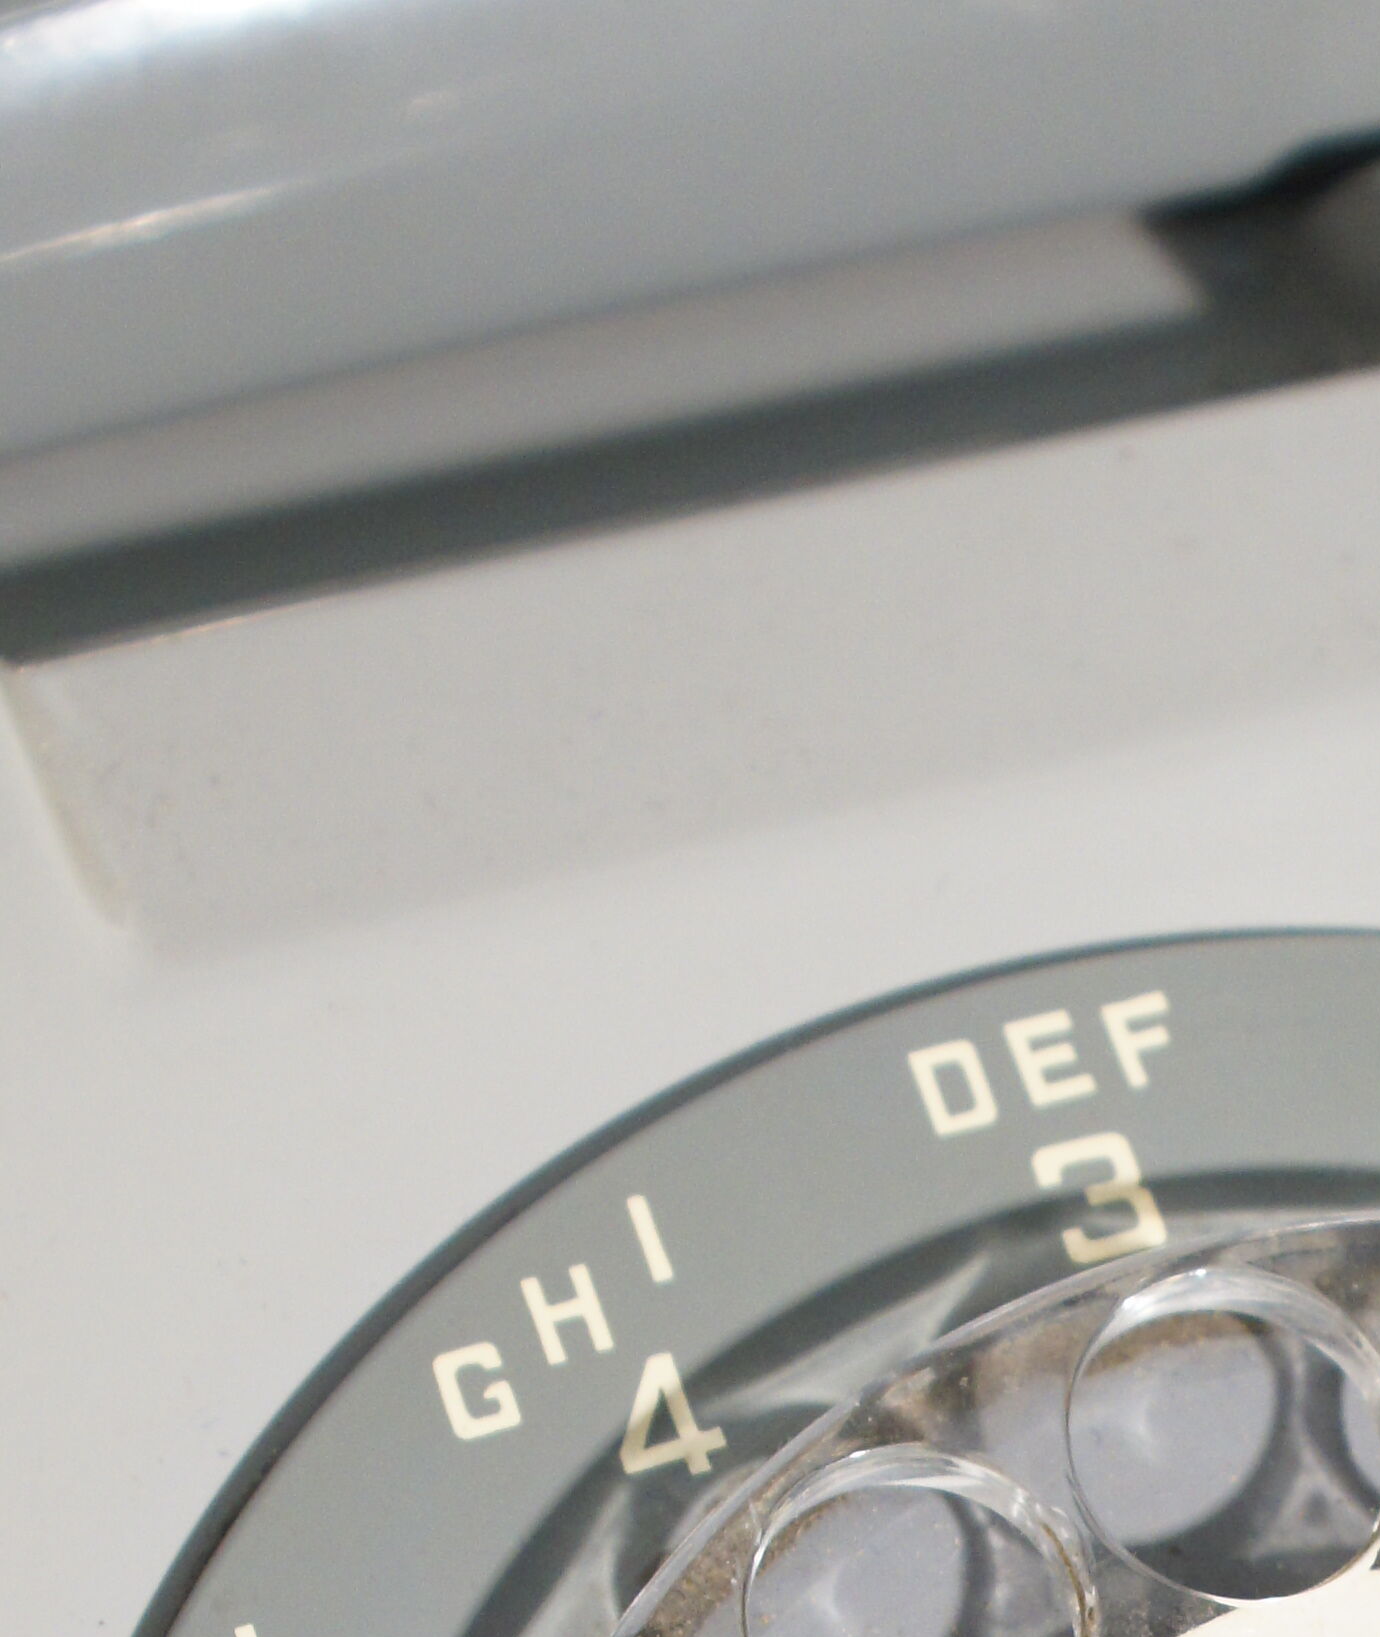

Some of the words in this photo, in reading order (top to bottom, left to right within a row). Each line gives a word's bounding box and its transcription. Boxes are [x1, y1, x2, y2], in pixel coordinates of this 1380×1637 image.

[907, 991, 1170, 1136] DEF
[1031, 1132, 1167, 1264] 3
[432, 1194, 673, 1440] GHI
[619, 1352, 728, 1476] 4
